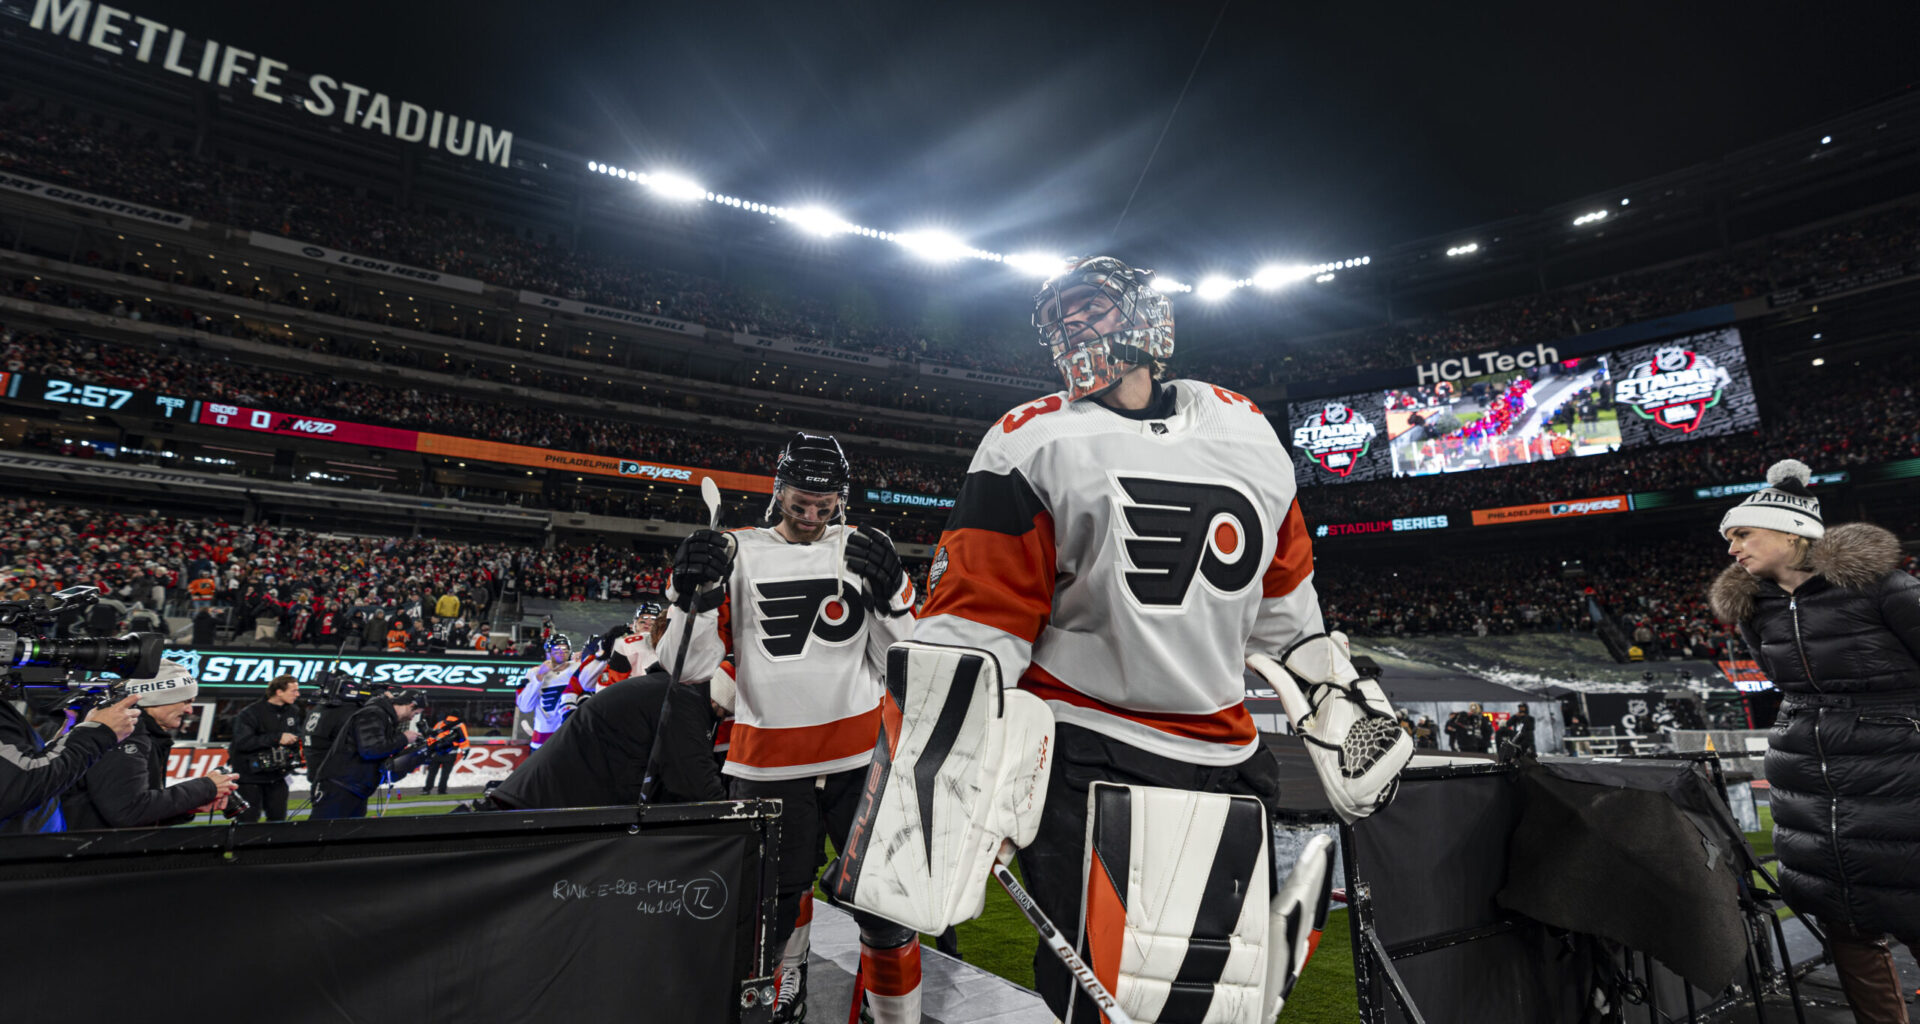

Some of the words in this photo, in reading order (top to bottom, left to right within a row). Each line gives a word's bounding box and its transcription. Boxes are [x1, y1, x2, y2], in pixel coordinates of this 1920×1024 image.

[30, 0, 289, 103] METLIFE
[304, 74, 513, 167] STADIUM
[338, 255, 390, 272] LEON
[583, 306, 656, 325] WINSTON
[1416, 343, 1560, 385] HCLTech
[44, 379, 134, 410] 2:57
[156, 396, 186, 409] PER
[216, 414, 229, 425] 0
[250, 410, 272, 429] 0
[292, 418, 337, 434] NJD
[544, 454, 620, 470] PHILADELPHIA
[638, 465, 692, 481] FLYERS
[892, 493, 938, 507] STADIUM
[1567, 500, 1621, 513] FLYERS
[1487, 507, 1551, 520] PHILADELPHIA
[1316, 515, 1449, 537] #STADIUMSERIES
[373, 663, 495, 685] SERIES
[498, 666, 520, 675] NEW
[837, 761, 883, 895] TRUE
[1008, 881, 1034, 911] ERSSON
